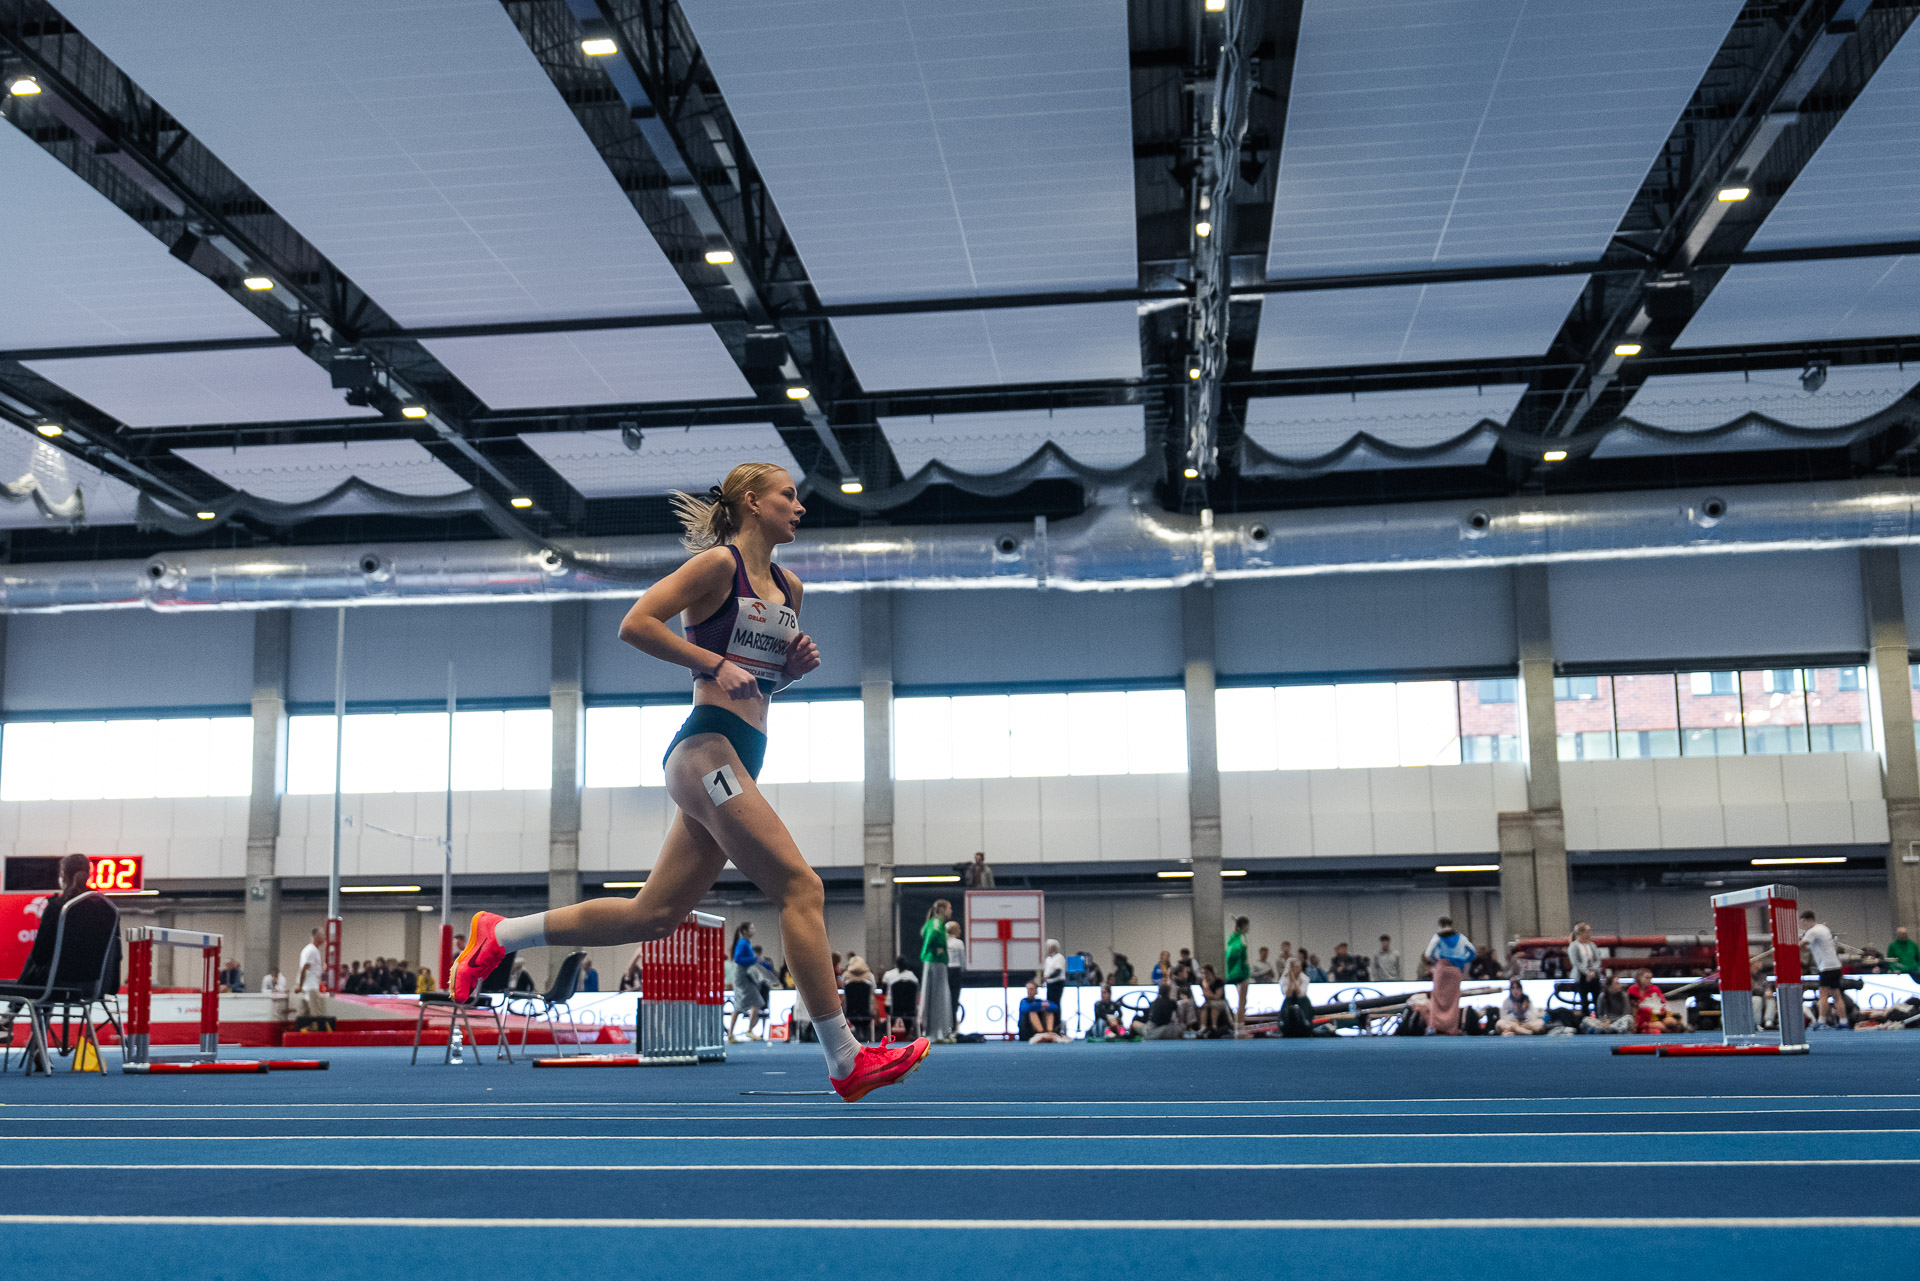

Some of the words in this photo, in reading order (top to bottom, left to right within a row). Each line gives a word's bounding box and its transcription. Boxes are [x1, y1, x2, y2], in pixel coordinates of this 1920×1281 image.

[748, 614, 767, 623] ORLEN
[778, 610, 796, 629] 778
[733, 628, 790, 656] MARSZEWSK
[713, 770, 733, 797] 1
